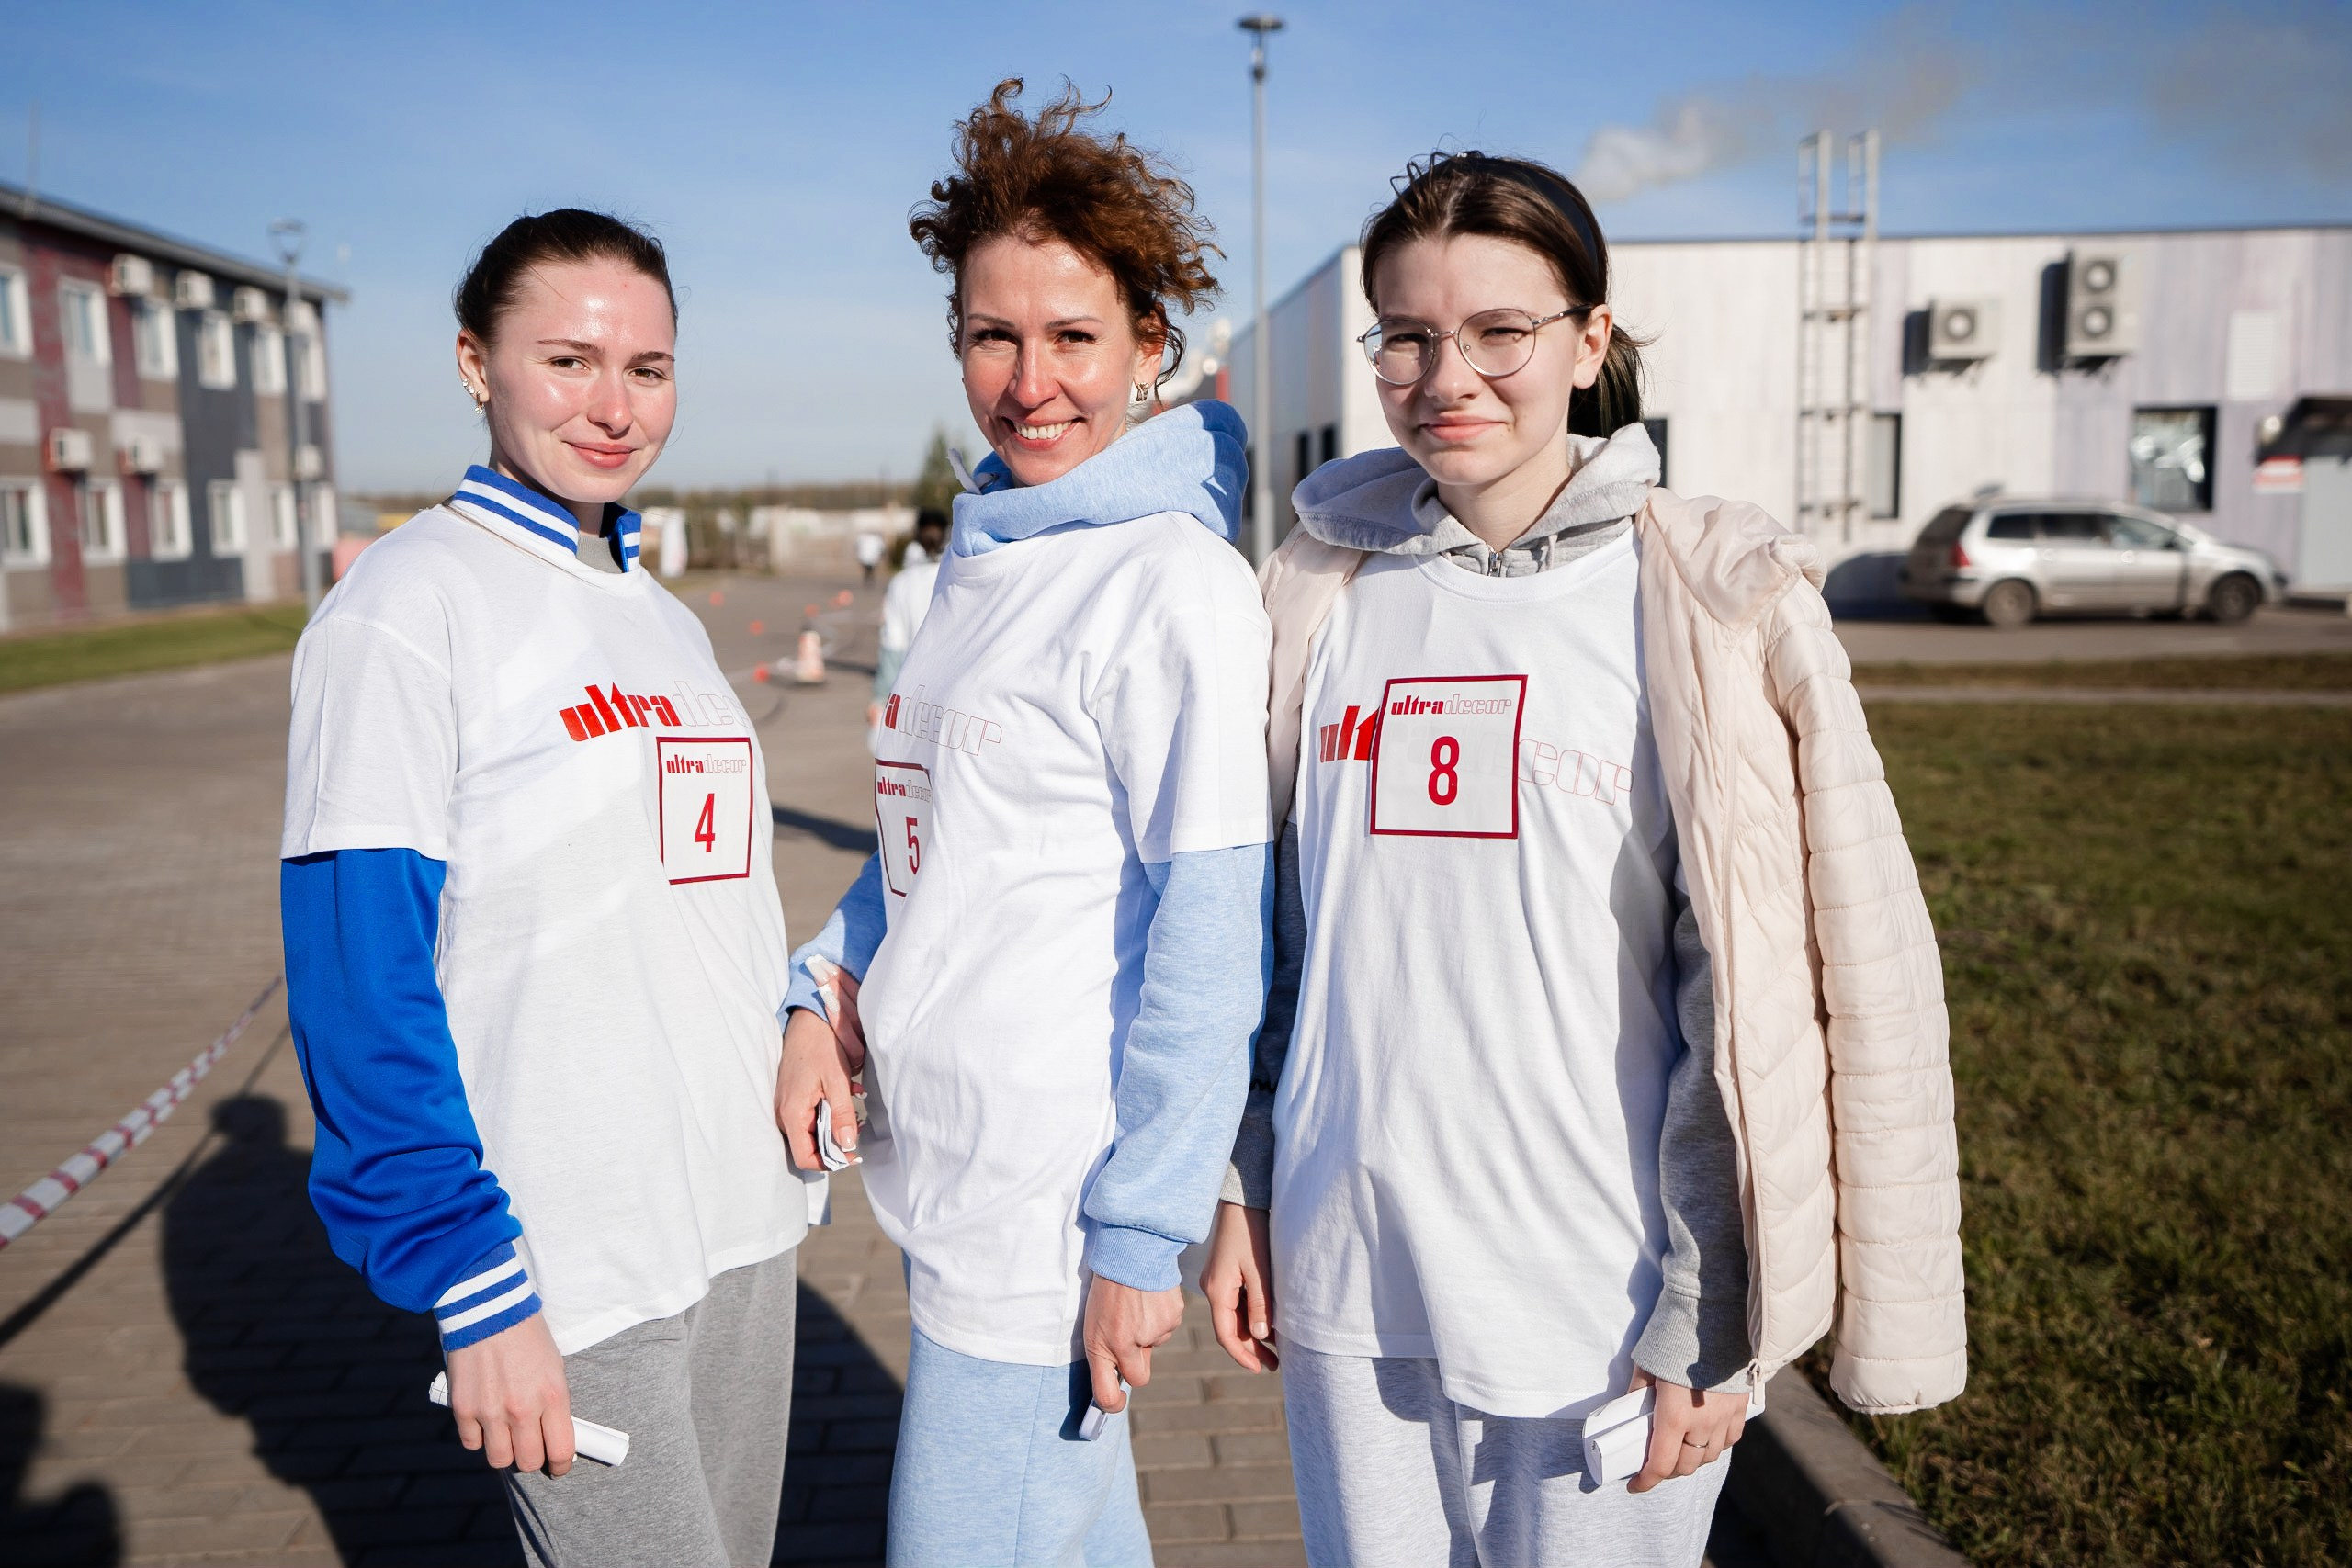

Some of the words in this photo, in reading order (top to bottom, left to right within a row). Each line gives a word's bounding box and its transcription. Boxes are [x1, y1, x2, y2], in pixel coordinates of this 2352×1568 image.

[885, 684, 1002, 756] adecor
[1390, 694, 1512, 715] ultradecor
[666, 754, 746, 773] ultradecor
[1428, 735, 1460, 806] 8
[695, 793, 716, 852] 4
[906, 816, 920, 875] 5
